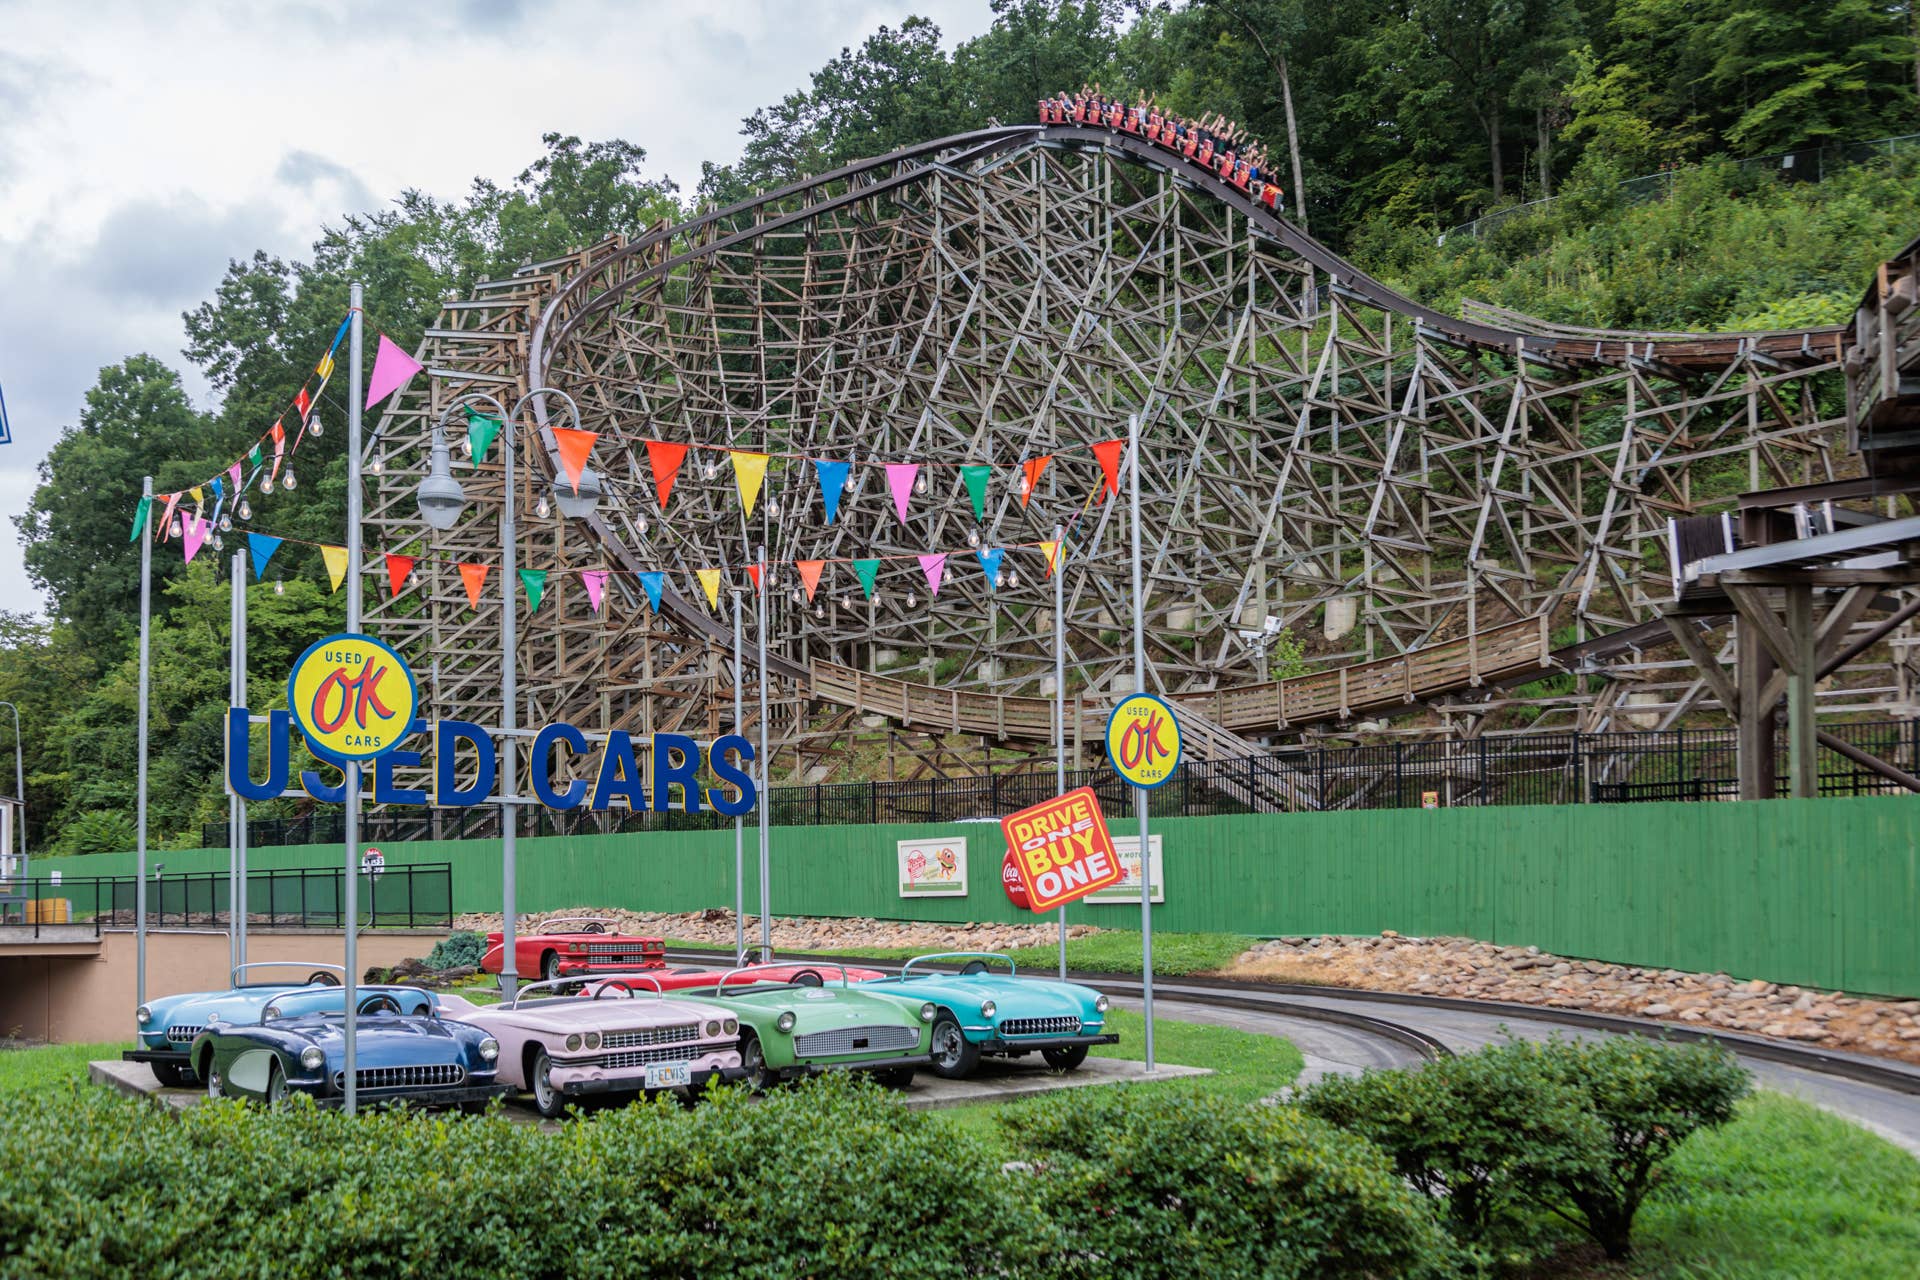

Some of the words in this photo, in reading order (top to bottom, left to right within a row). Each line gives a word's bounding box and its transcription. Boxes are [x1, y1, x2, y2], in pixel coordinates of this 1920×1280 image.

[325, 651, 362, 664] USED
[311, 656, 397, 735] OK
[1126, 707, 1149, 716] USED
[345, 734, 381, 747] CARS
[1119, 709, 1170, 770] OK
[528, 722, 757, 817] CARS
[1140, 769, 1162, 778] CARS
[1014, 800, 1090, 843] DRIVE
[1022, 817, 1094, 851] ONE
[1025, 827, 1095, 877] BUY
[1123, 851, 1152, 859] MOTOS
[1036, 851, 1111, 898] ONE
